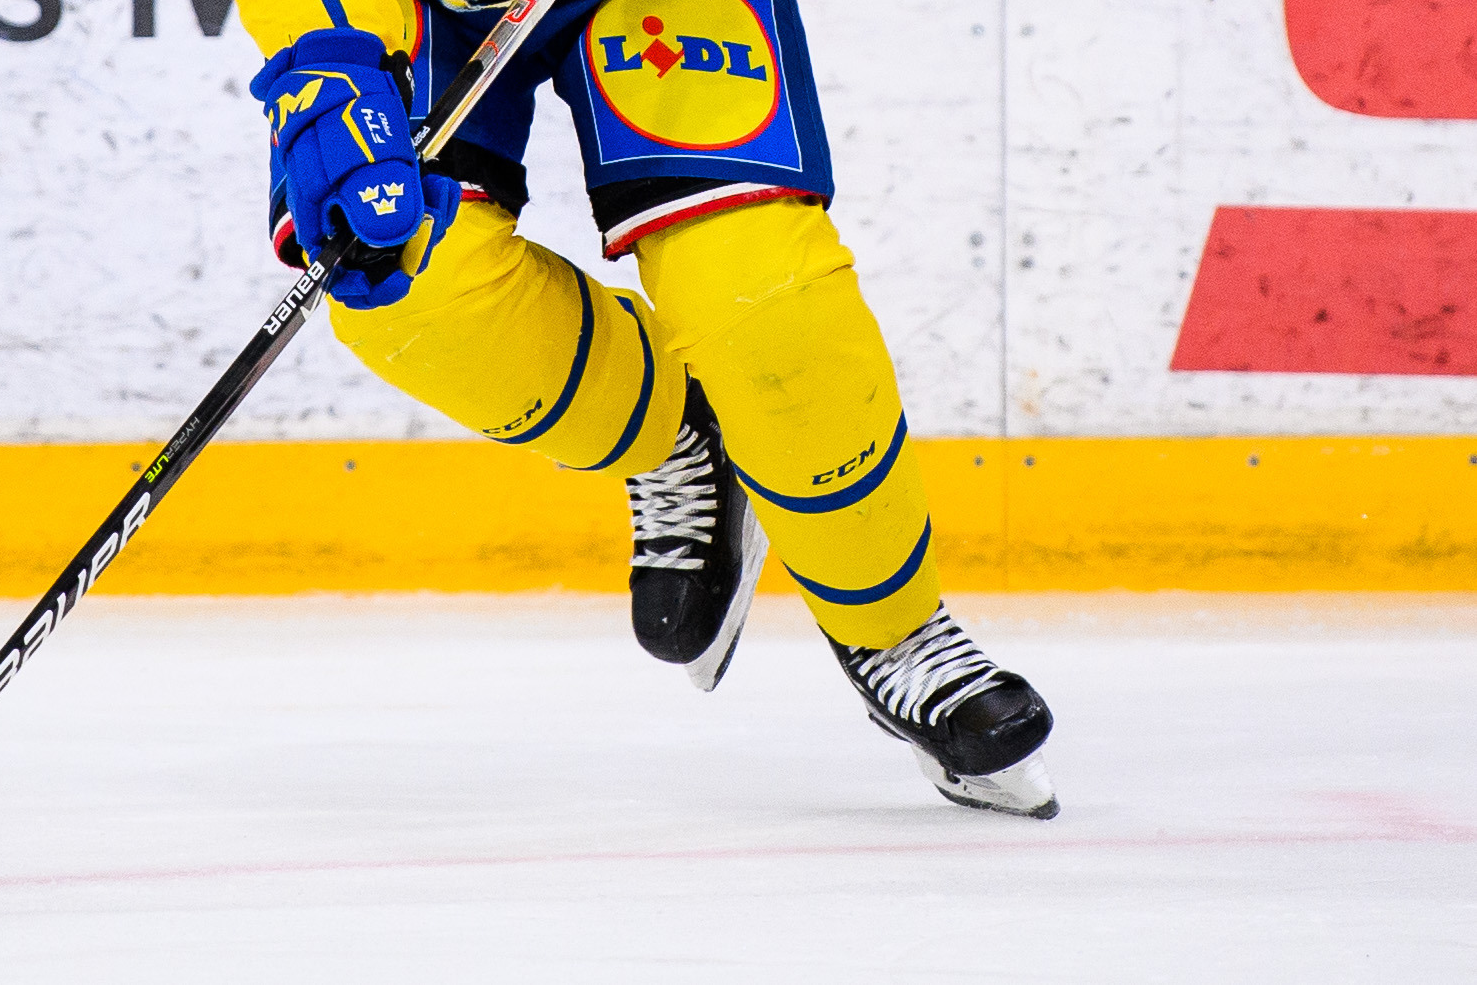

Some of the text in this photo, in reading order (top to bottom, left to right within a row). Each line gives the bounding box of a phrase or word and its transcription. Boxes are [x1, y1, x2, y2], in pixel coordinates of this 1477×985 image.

[262, 259, 326, 337] BAUER
[481, 398, 544, 436] CCM
[144, 416, 201, 484] HYPERLITE
[811, 440, 877, 486] CCM
